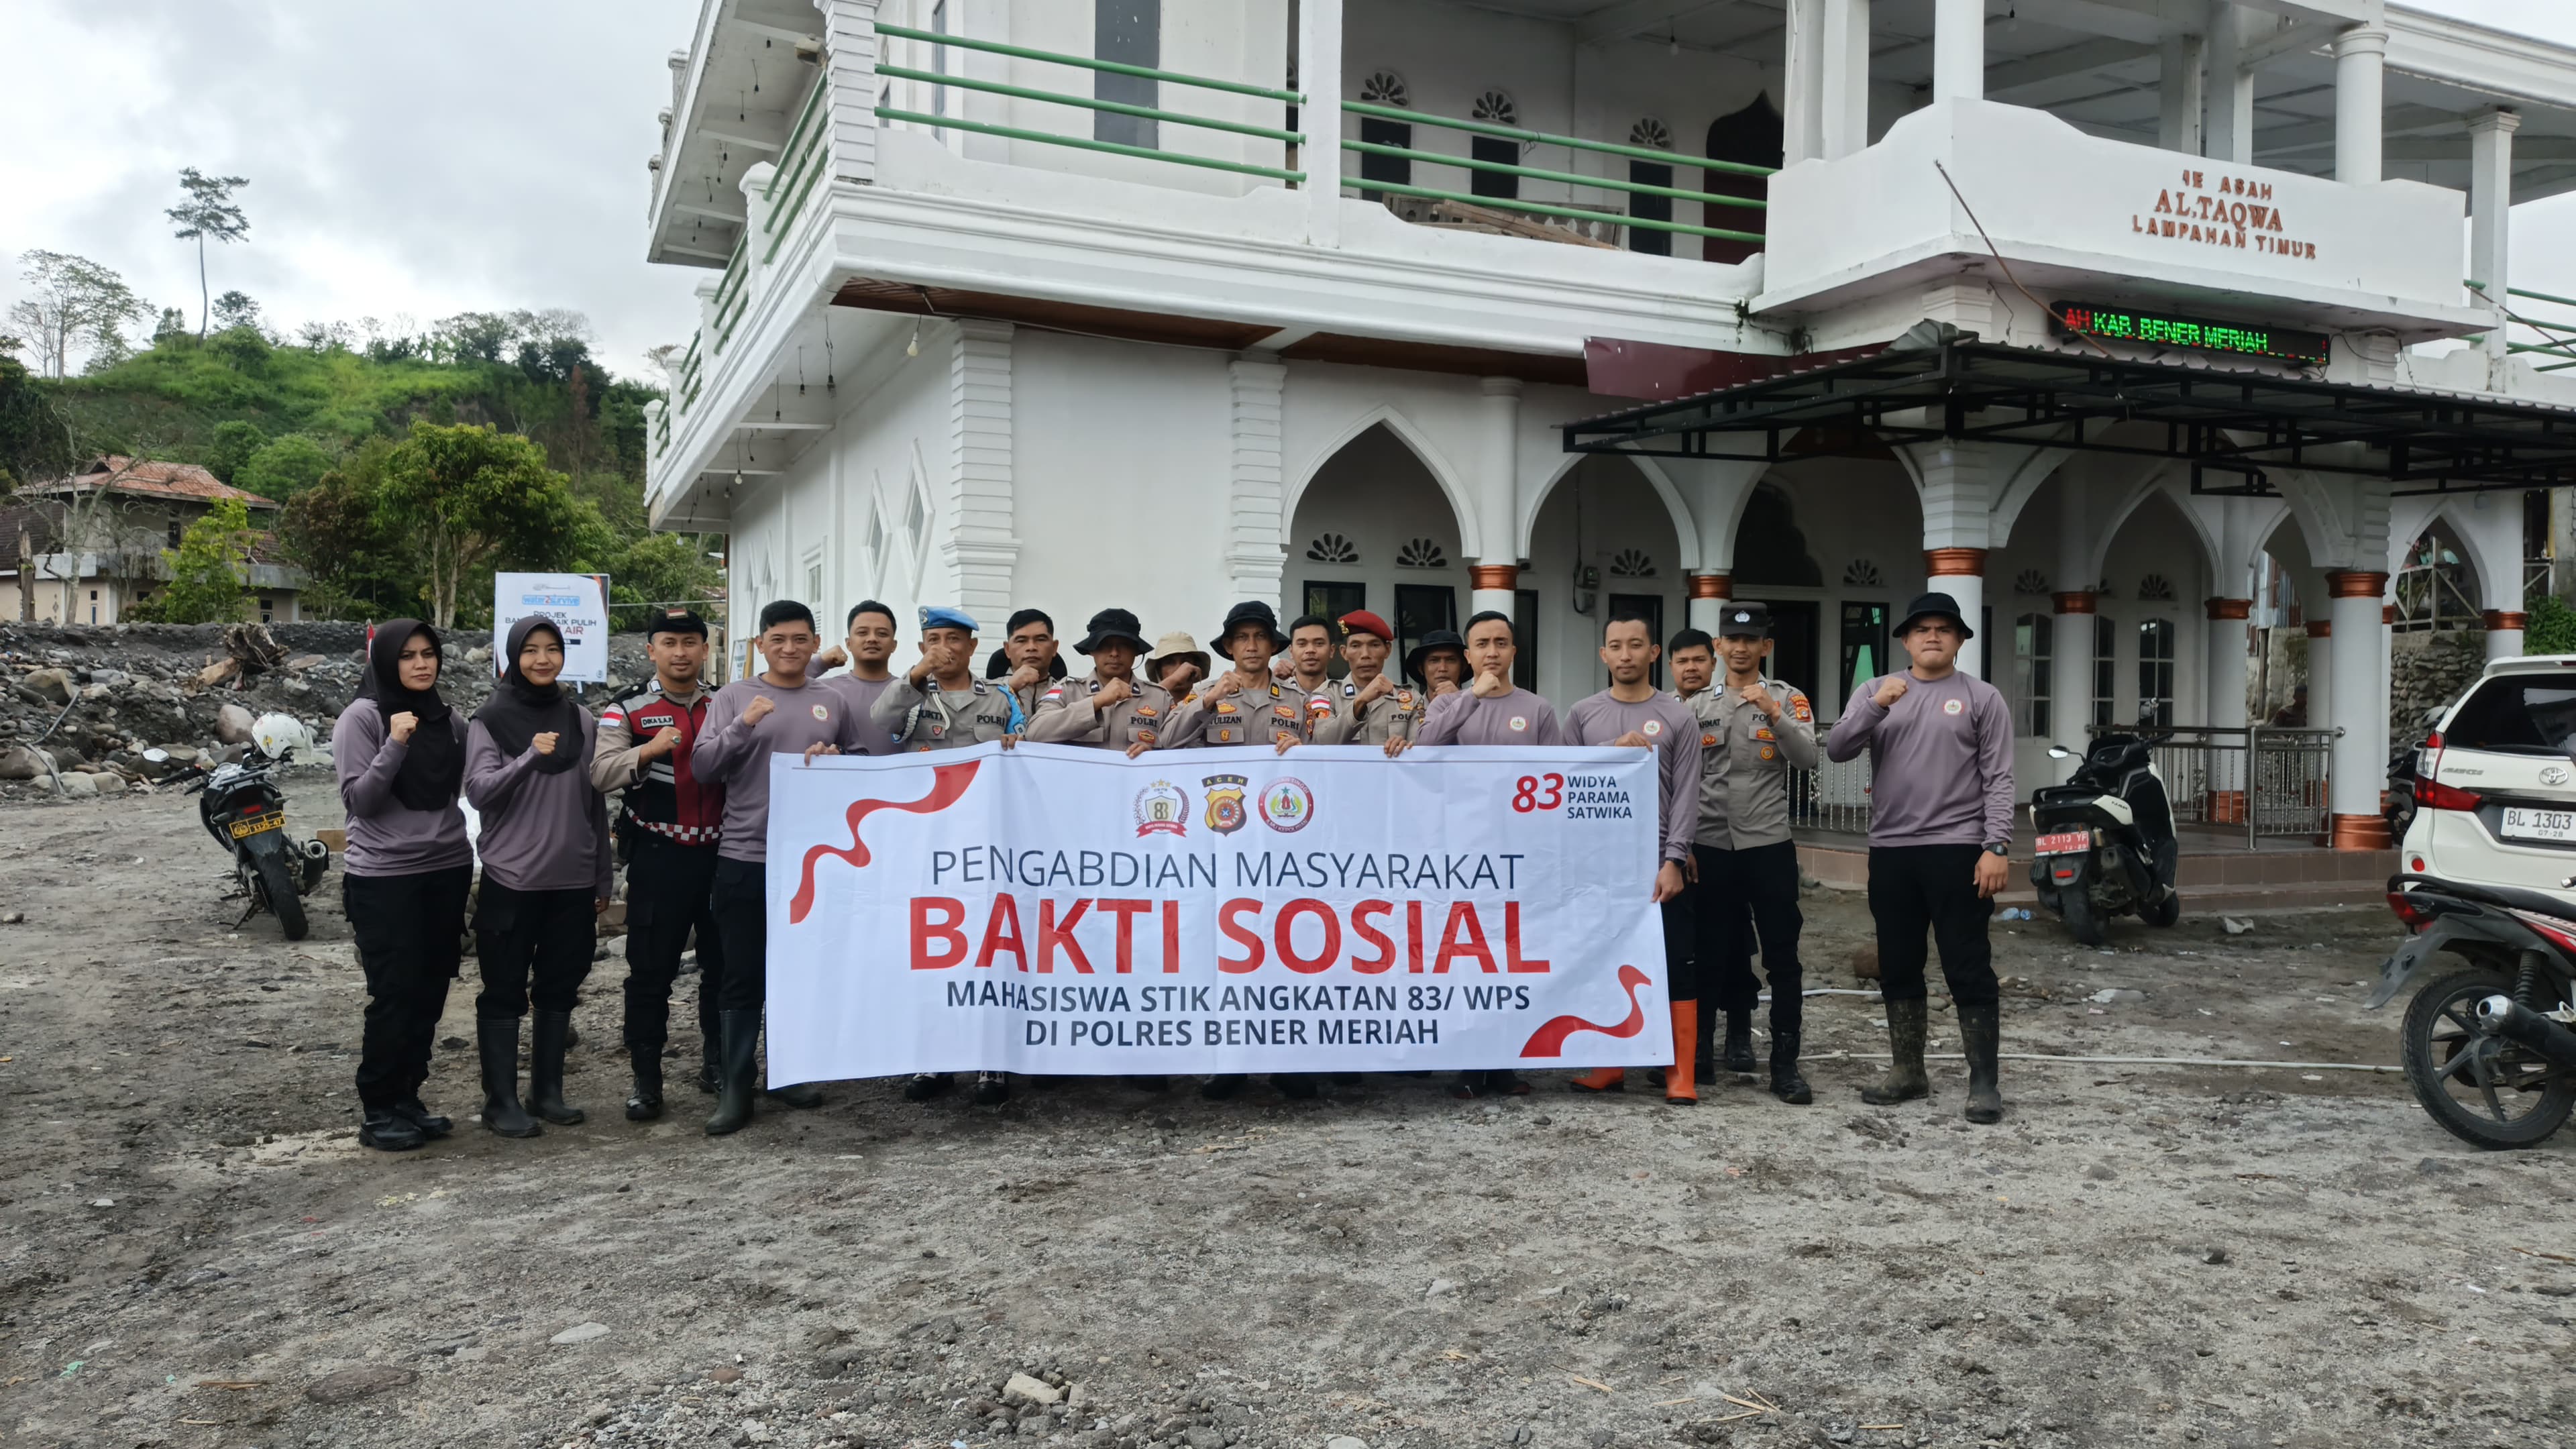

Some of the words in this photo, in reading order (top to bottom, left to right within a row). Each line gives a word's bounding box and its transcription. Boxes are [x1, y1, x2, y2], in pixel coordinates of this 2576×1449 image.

[2132, 215, 2247, 248] LAMPAHAN
[2255, 235, 2316, 259] TIMUR
[2140, 317, 2201, 344] BENER
[2204, 326, 2267, 352] MERIAH
[564, 626, 584, 635] AIR
[976, 714, 1006, 727] POLRI
[1130, 716, 1158, 727] POLRI
[1271, 717, 1299, 731] POLRI
[1206, 776, 1244, 785] ACEH
[1567, 775, 1617, 788] WIDYA
[1512, 772, 1564, 814] 83
[1568, 791, 1630, 804] PARAMA
[1567, 806, 1633, 819] SATWIKA
[2507, 810, 2525, 826] BL
[2532, 812, 2572, 830] 1303
[2037, 837, 2047, 847] BL
[2051, 834, 2072, 844] 2113
[933, 845, 1216, 888] PENGABDIAN
[1236, 851, 1525, 890] MASYARAKAT
[910, 893, 1180, 974] BAKTI
[1218, 898, 1550, 975] SOSIAL
[947, 980, 1131, 1012] MAHASISWA
[1141, 986, 1210, 1012] STIK
[1219, 985, 1397, 1011] ANGKATAN
[1408, 985, 1454, 1011] 83/
[1464, 985, 1530, 1010] WPS
[1026, 1020, 1057, 1046] DI
[1071, 1020, 1192, 1046] POLRES
[1204, 1019, 1308, 1046] BENER
[1318, 1019, 1438, 1044] MERIAH
